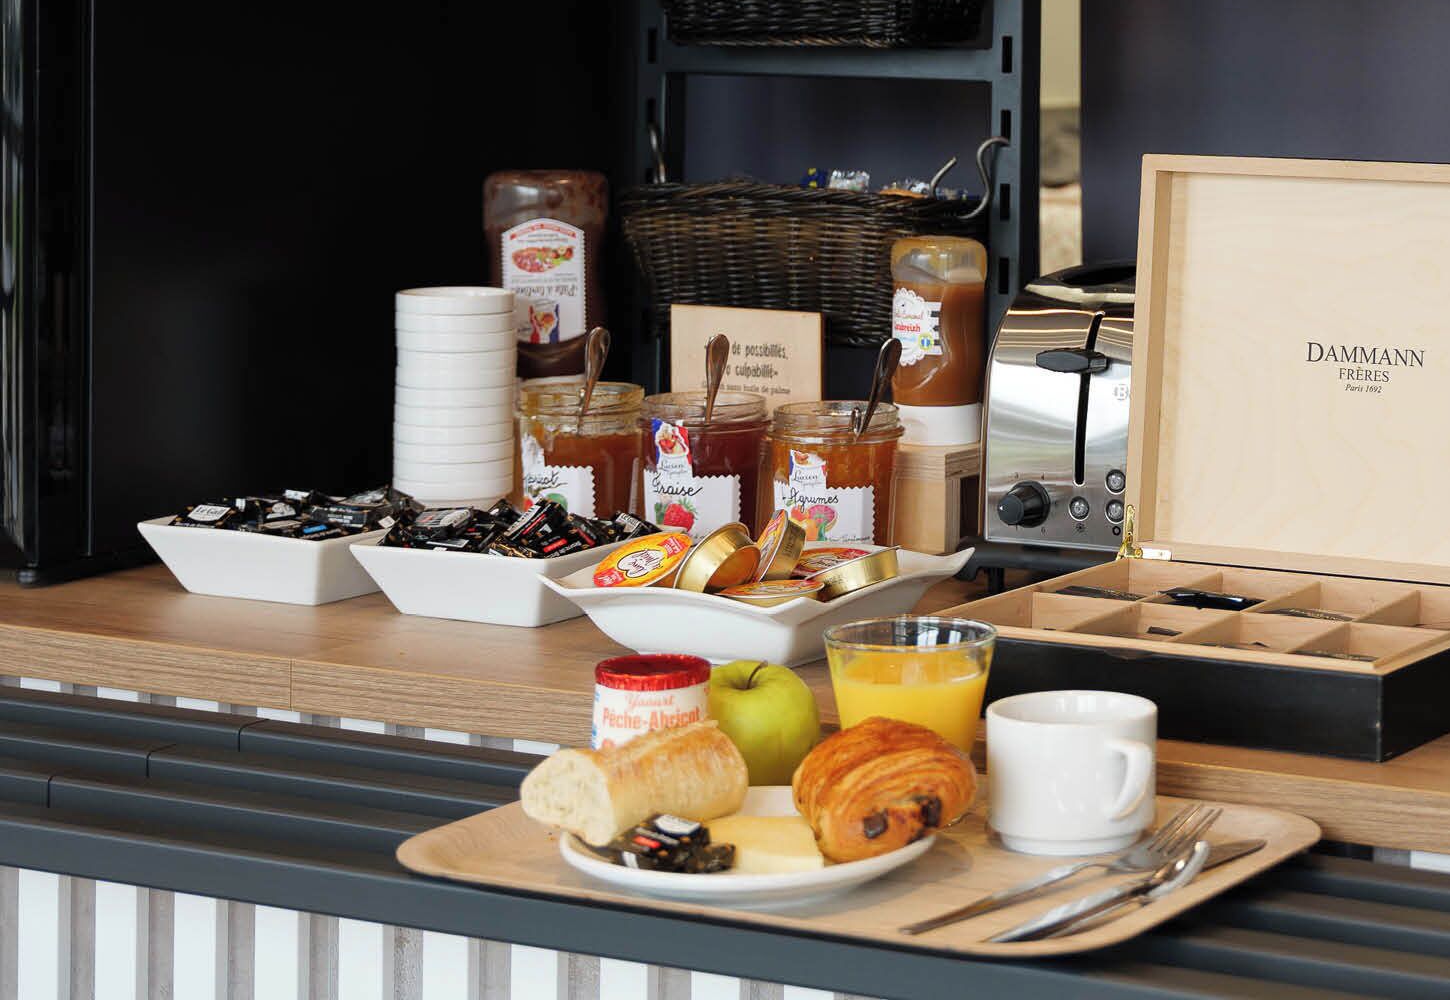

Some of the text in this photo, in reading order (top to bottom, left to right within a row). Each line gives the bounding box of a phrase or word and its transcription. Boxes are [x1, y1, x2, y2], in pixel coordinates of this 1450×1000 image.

[1306, 341, 1425, 368] DAMMANN
[1339, 366, 1390, 383] FRÈRES
[761, 384, 770, 393] de
[1345, 384, 1382, 394] Paris 1692
[652, 472, 703, 497] Fraise
[788, 486, 839, 513] Agrumes
